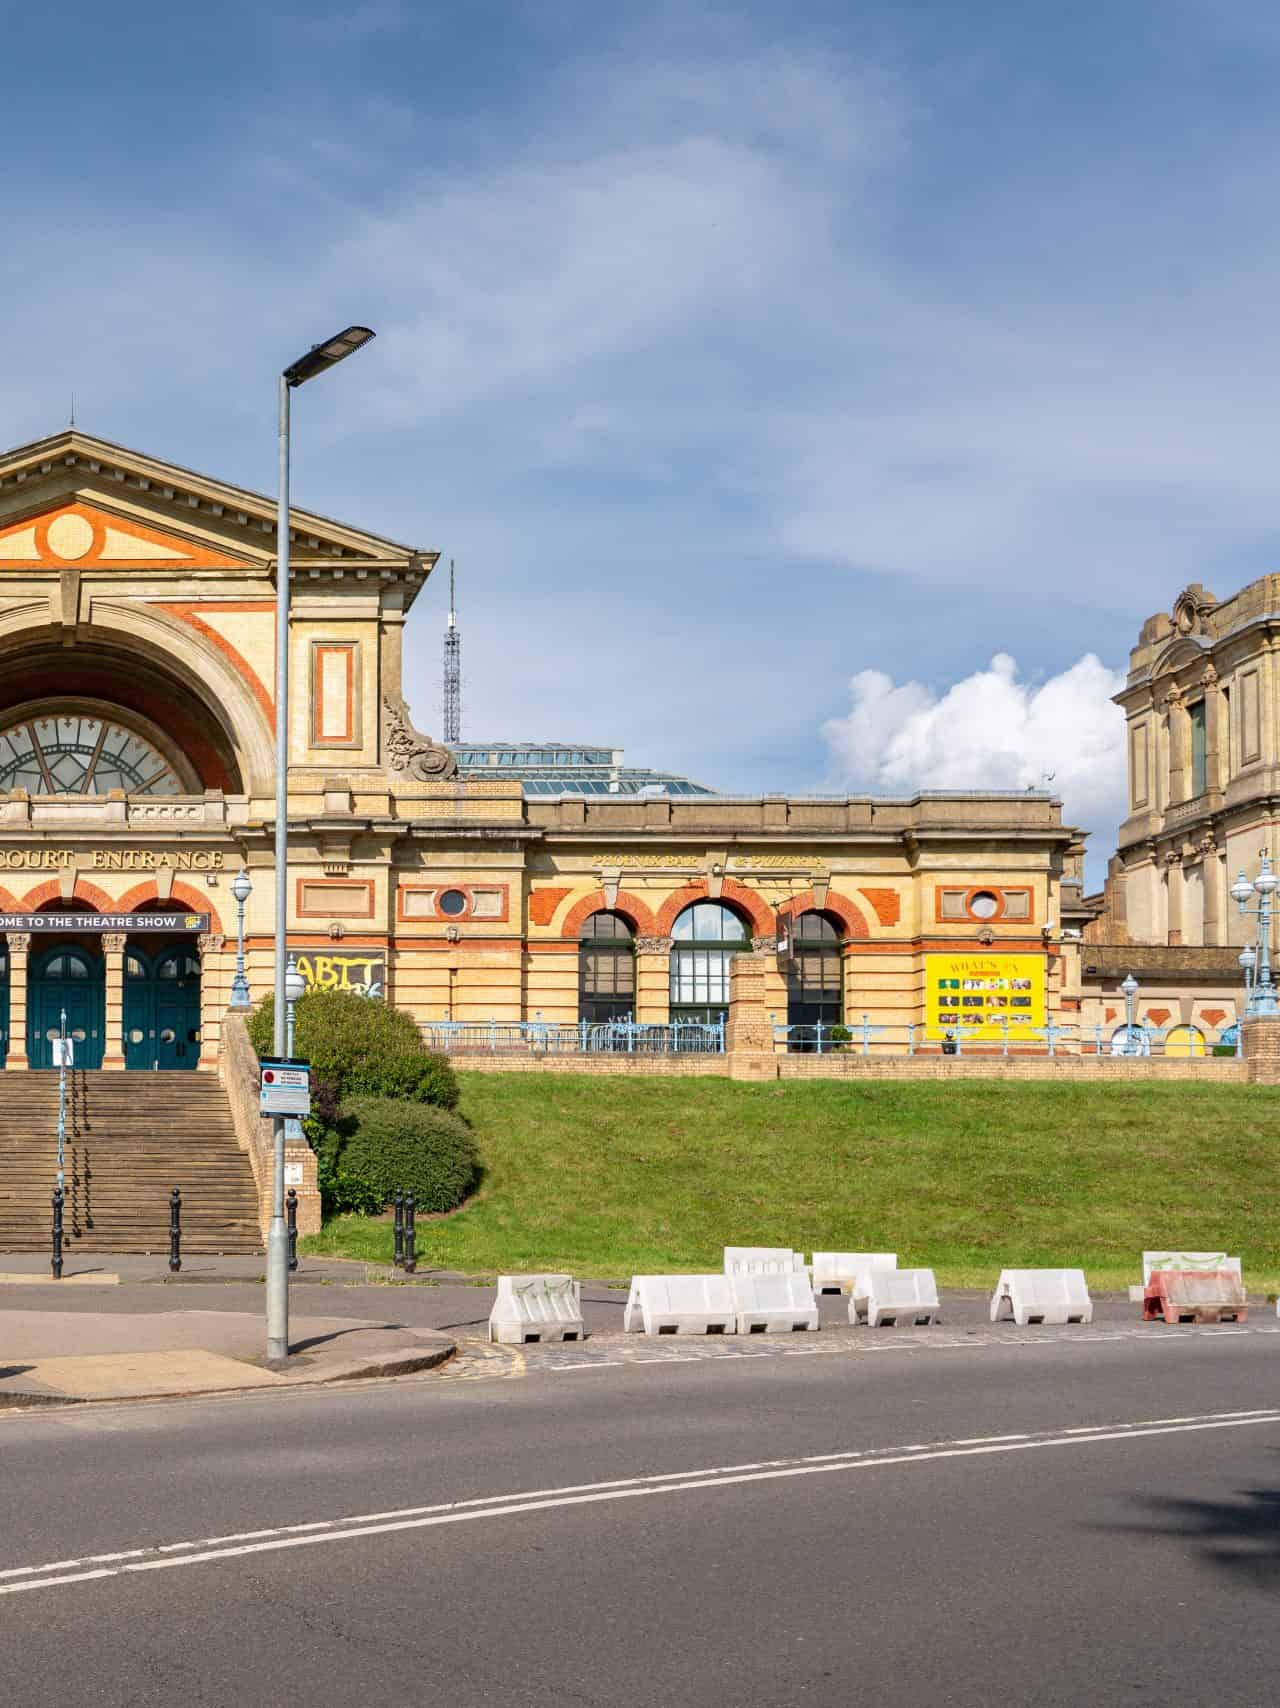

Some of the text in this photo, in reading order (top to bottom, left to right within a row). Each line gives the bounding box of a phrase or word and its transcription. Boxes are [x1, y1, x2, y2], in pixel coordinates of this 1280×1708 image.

[93, 849, 224, 869] ENTRANCE
[28, 916, 45, 927] TO
[48, 916, 73, 927] THE
[76, 916, 133, 927] THEATRE
[136, 916, 177, 927] SHOW
[296, 956, 384, 987] ABTT
